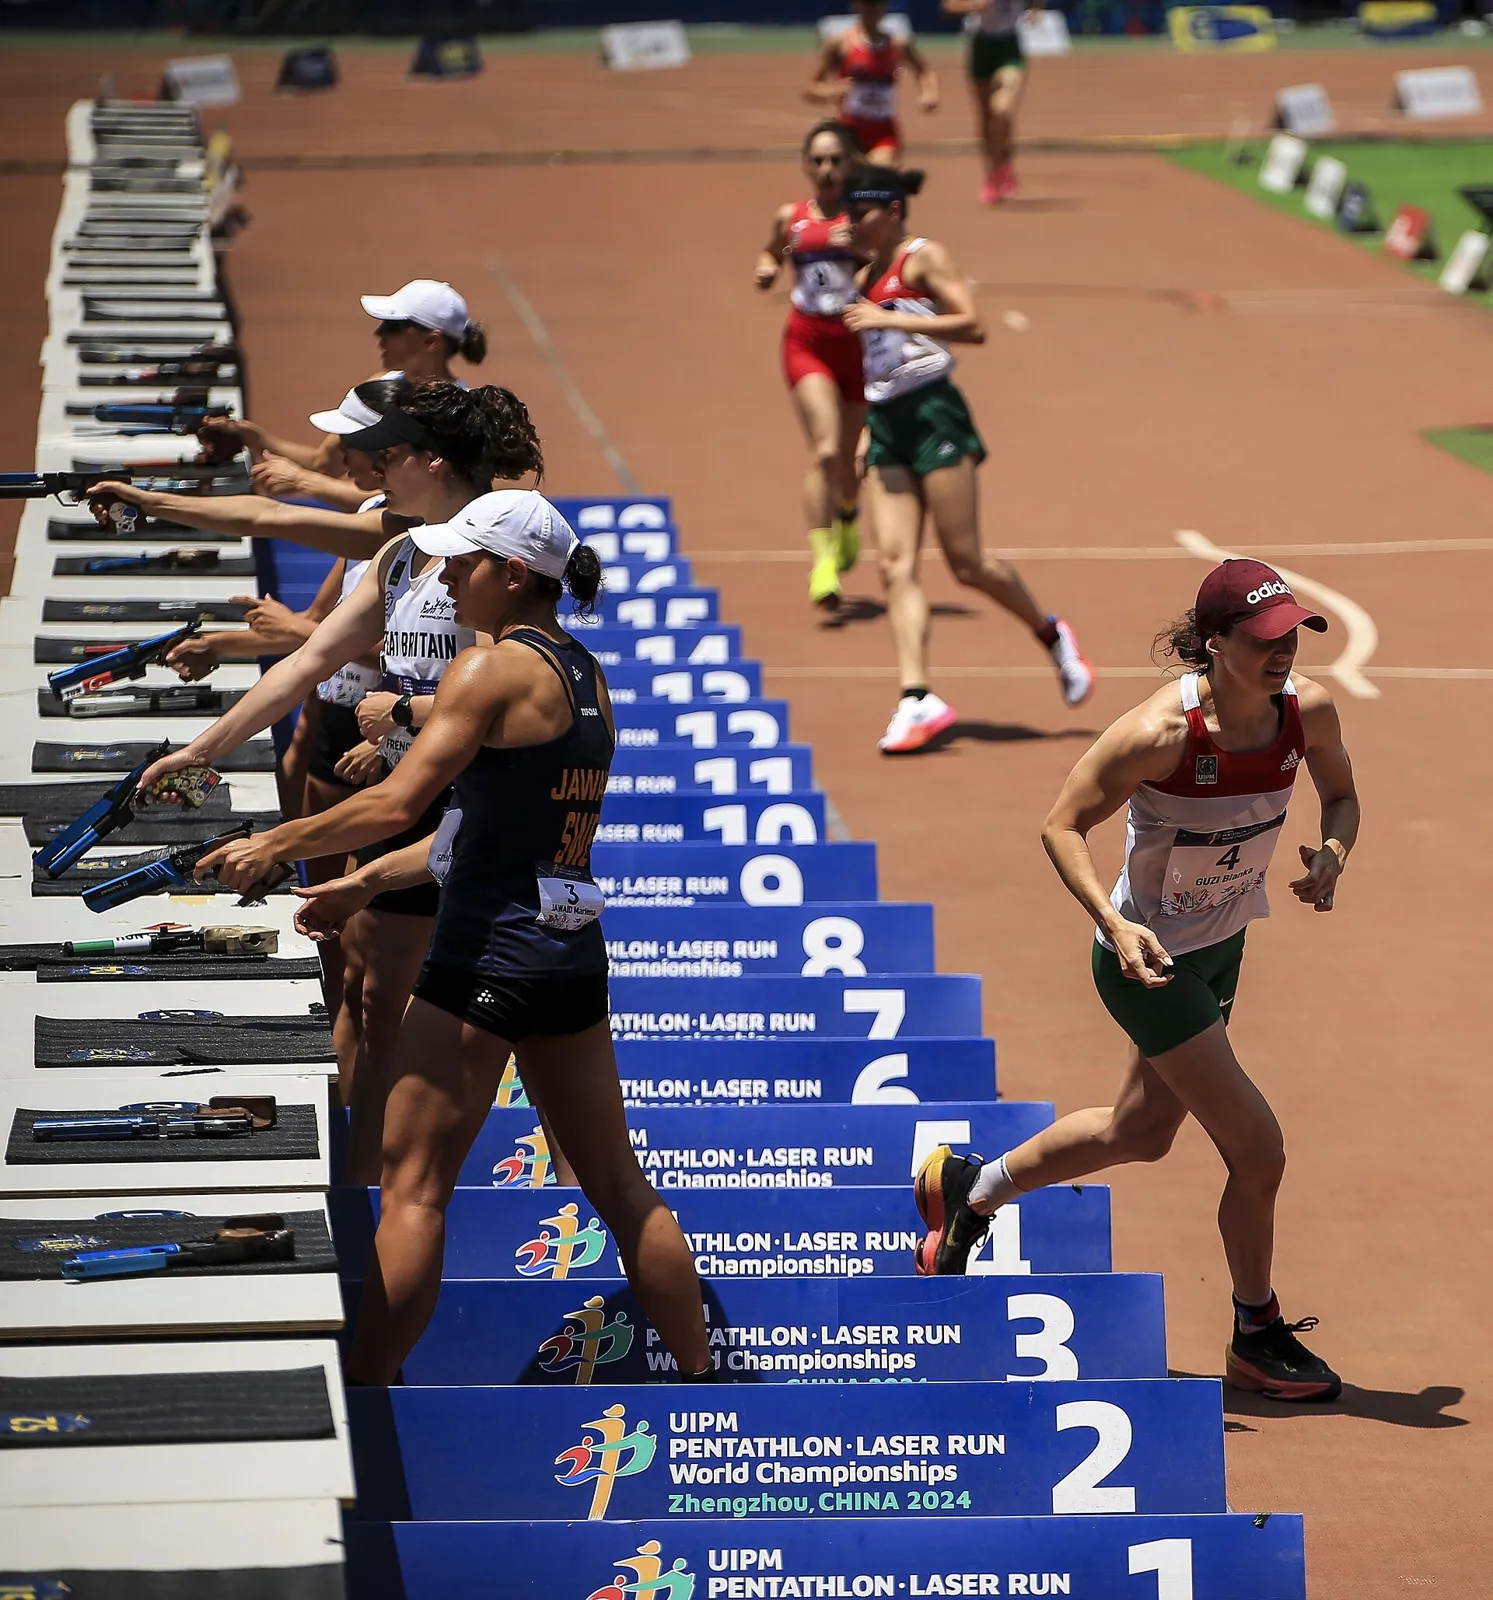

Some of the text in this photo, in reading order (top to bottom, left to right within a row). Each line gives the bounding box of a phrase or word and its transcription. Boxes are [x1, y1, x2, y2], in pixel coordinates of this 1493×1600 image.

[1246, 580, 1291, 604] adida
[401, 631, 456, 659] BRITAIN
[635, 775, 676, 794] RUN
[694, 757, 793, 795] 11
[593, 824, 684, 843] ASER RUN
[703, 803, 819, 846] 10
[1215, 845, 1241, 870] 4
[686, 876, 729, 895] RUN
[739, 854, 804, 907] 9
[1195, 867, 1254, 886] GUZI Blanka
[563, 883, 579, 905] 3
[551, 904, 572, 914] JAWAID
[733, 940, 778, 959] RUN
[801, 916, 867, 977] 8
[608, 957, 744, 977] hampionships
[769, 1013, 816, 1032] RUN
[843, 989, 906, 1041] 7
[774, 1079, 822, 1098] RUN
[851, 1053, 920, 1105] 6
[824, 1146, 873, 1166] RUN
[662, 1169, 833, 1187] Championships
[865, 1231, 917, 1251] RUN
[694, 1254, 874, 1278] Championships
[906, 1324, 962, 1345] RUN
[1006, 1293, 1079, 1381] 3
[727, 1348, 916, 1374] Championships
[668, 1412, 738, 1433] UIPM
[948, 1434, 1006, 1455] RUN
[1052, 1401, 1136, 1514] 2
[668, 1460, 958, 1487] World Championships
[668, 1490, 972, 1517] Zhengzhou, CHINA 2024
[708, 1549, 783, 1572] UIPM
[1128, 1538, 1194, 1600] 1
[1008, 1572, 1071, 1596] RUN
